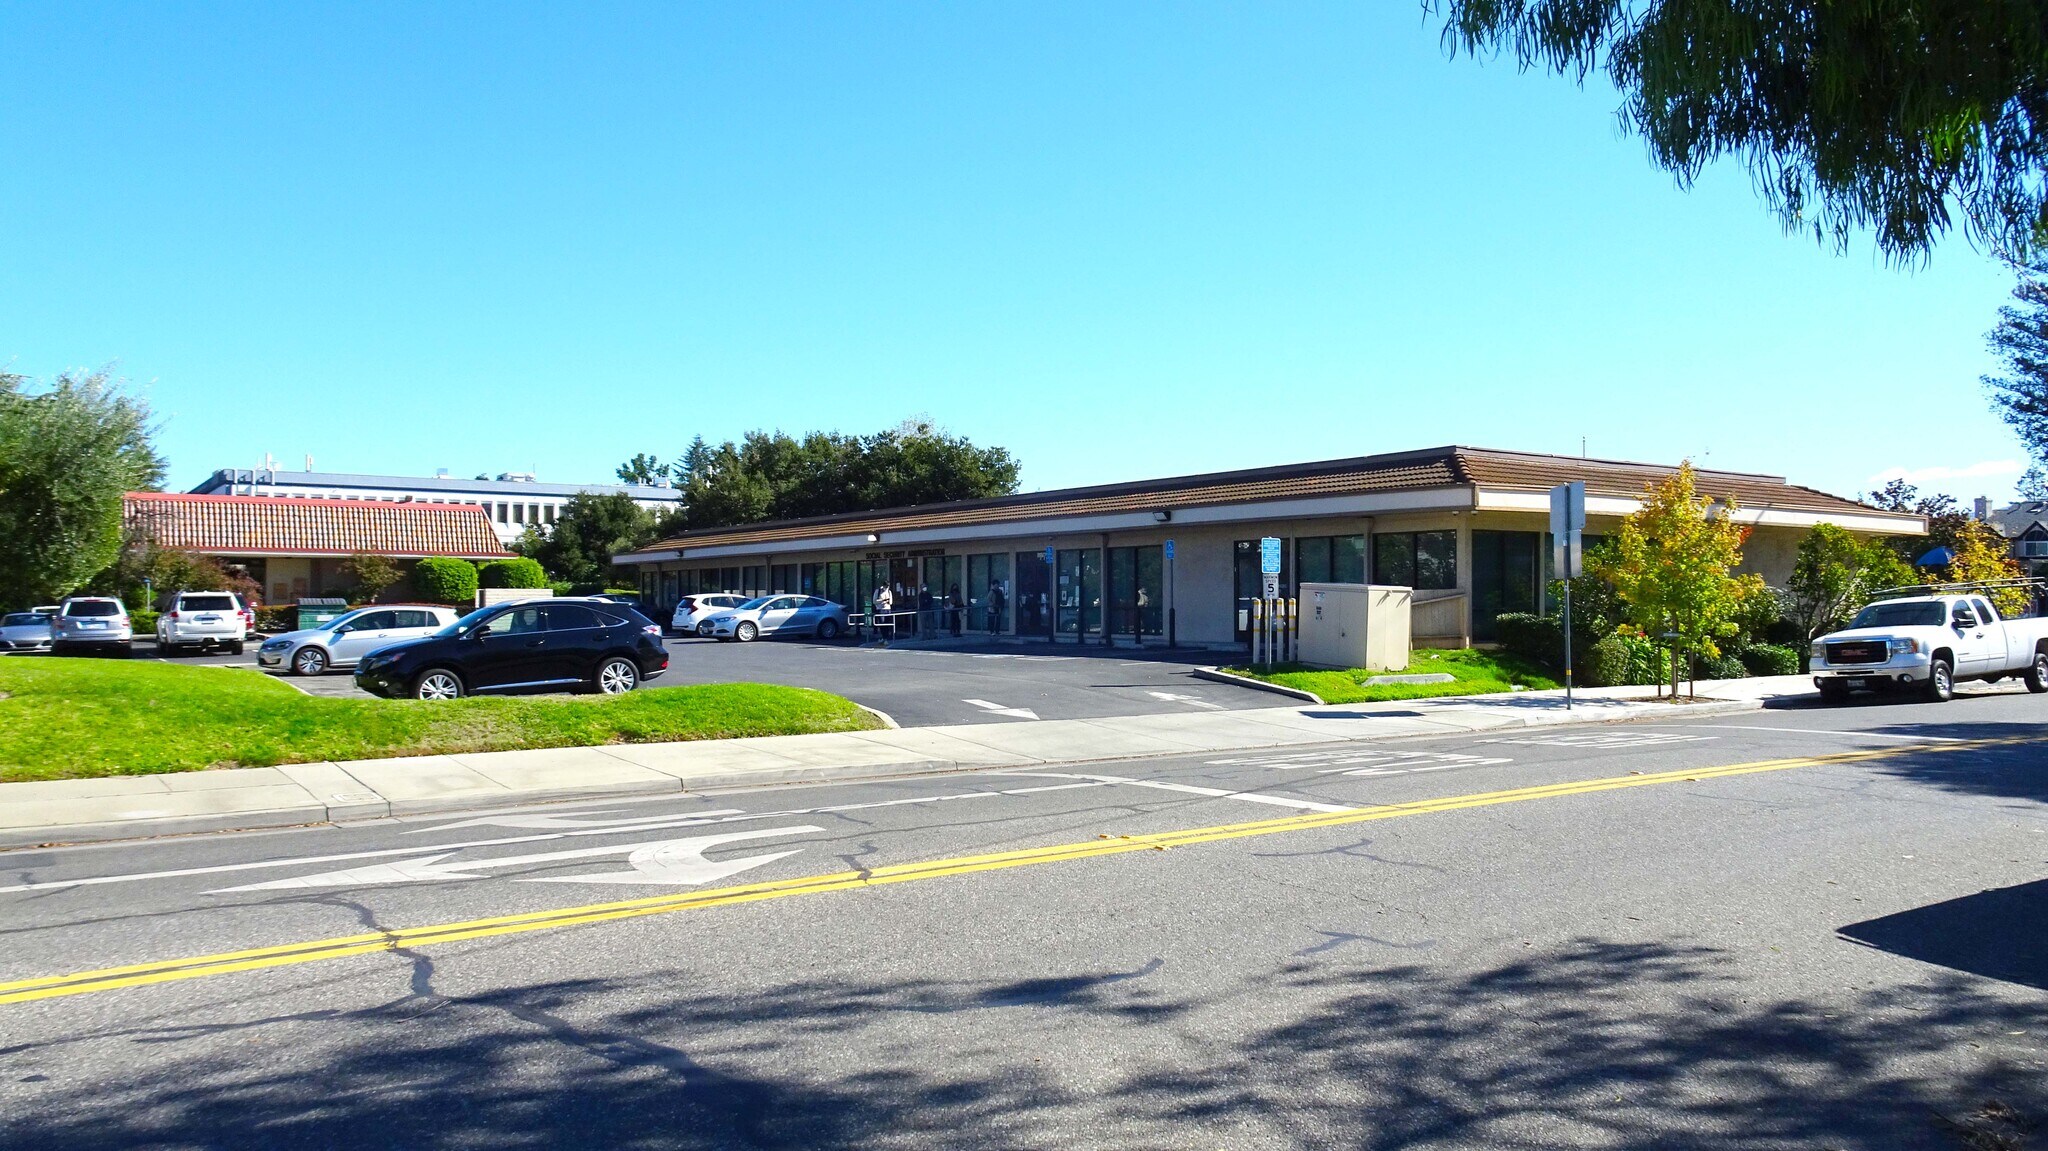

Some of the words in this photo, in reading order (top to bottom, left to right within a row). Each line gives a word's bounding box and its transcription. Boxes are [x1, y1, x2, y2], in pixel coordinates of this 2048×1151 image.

[1268, 583, 1275, 593] 5
[1841, 648, 1868, 656] GMC
[1203, 750, 1514, 775] CLEAR
